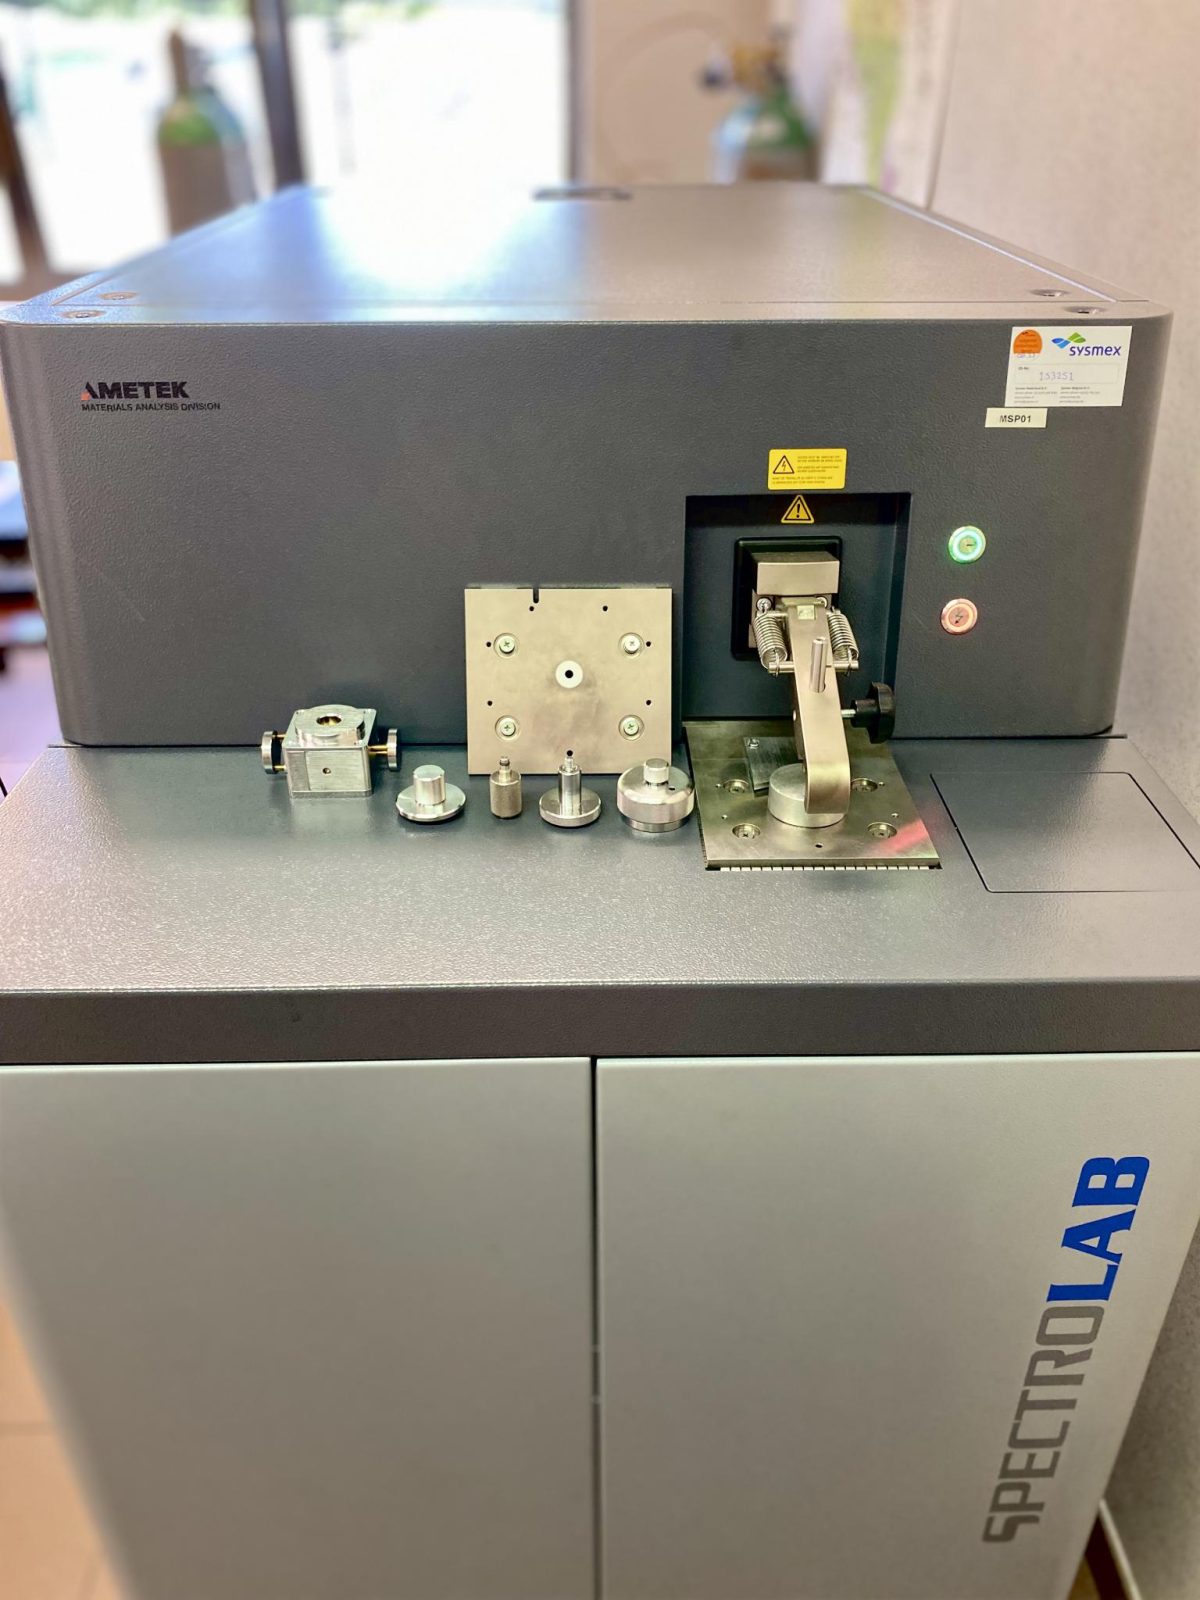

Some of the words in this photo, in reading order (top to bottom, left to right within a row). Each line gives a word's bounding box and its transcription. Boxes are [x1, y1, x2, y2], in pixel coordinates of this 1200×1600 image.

[1069, 345, 1122, 357] sysmex
[81, 381, 190, 400] AMETEK
[81, 403, 133, 412] MATERIALS
[135, 402, 179, 411] ANALYSIS
[181, 402, 221, 411] DIVISION
[999, 414, 1032, 424] MSP01
[982, 1156, 1150, 1542] SPECTROLAB
